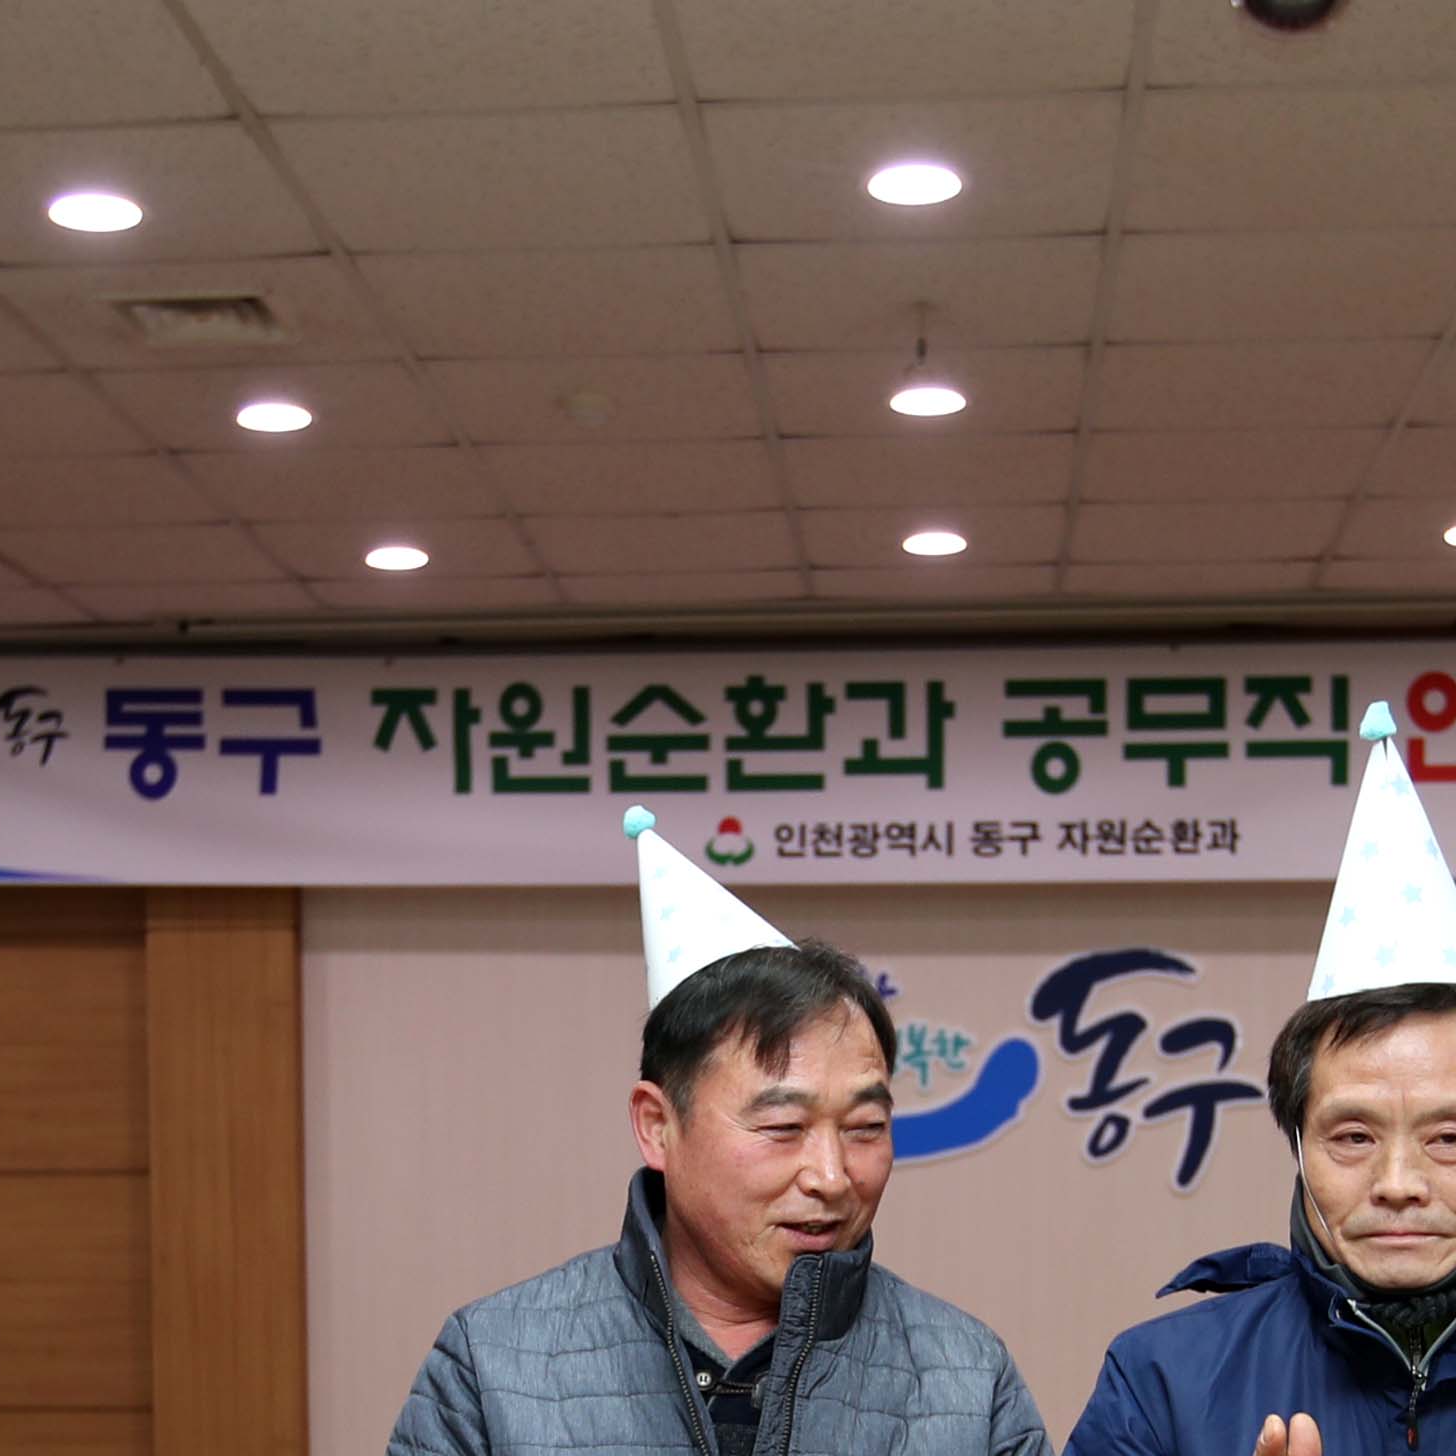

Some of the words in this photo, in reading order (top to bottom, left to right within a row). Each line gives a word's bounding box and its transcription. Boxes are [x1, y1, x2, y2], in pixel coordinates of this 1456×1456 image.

[104, 684, 323, 800] 동구
[369, 673, 956, 795] 자원순환과
[1002, 671, 1351, 795] 공무직
[774, 820, 954, 859] 인천광역시
[970, 820, 1042, 857] 동구
[1057, 818, 1240, 856] 자원순환과
[896, 1023, 971, 1086] 복한
[1031, 947, 1263, 1187] 동구
